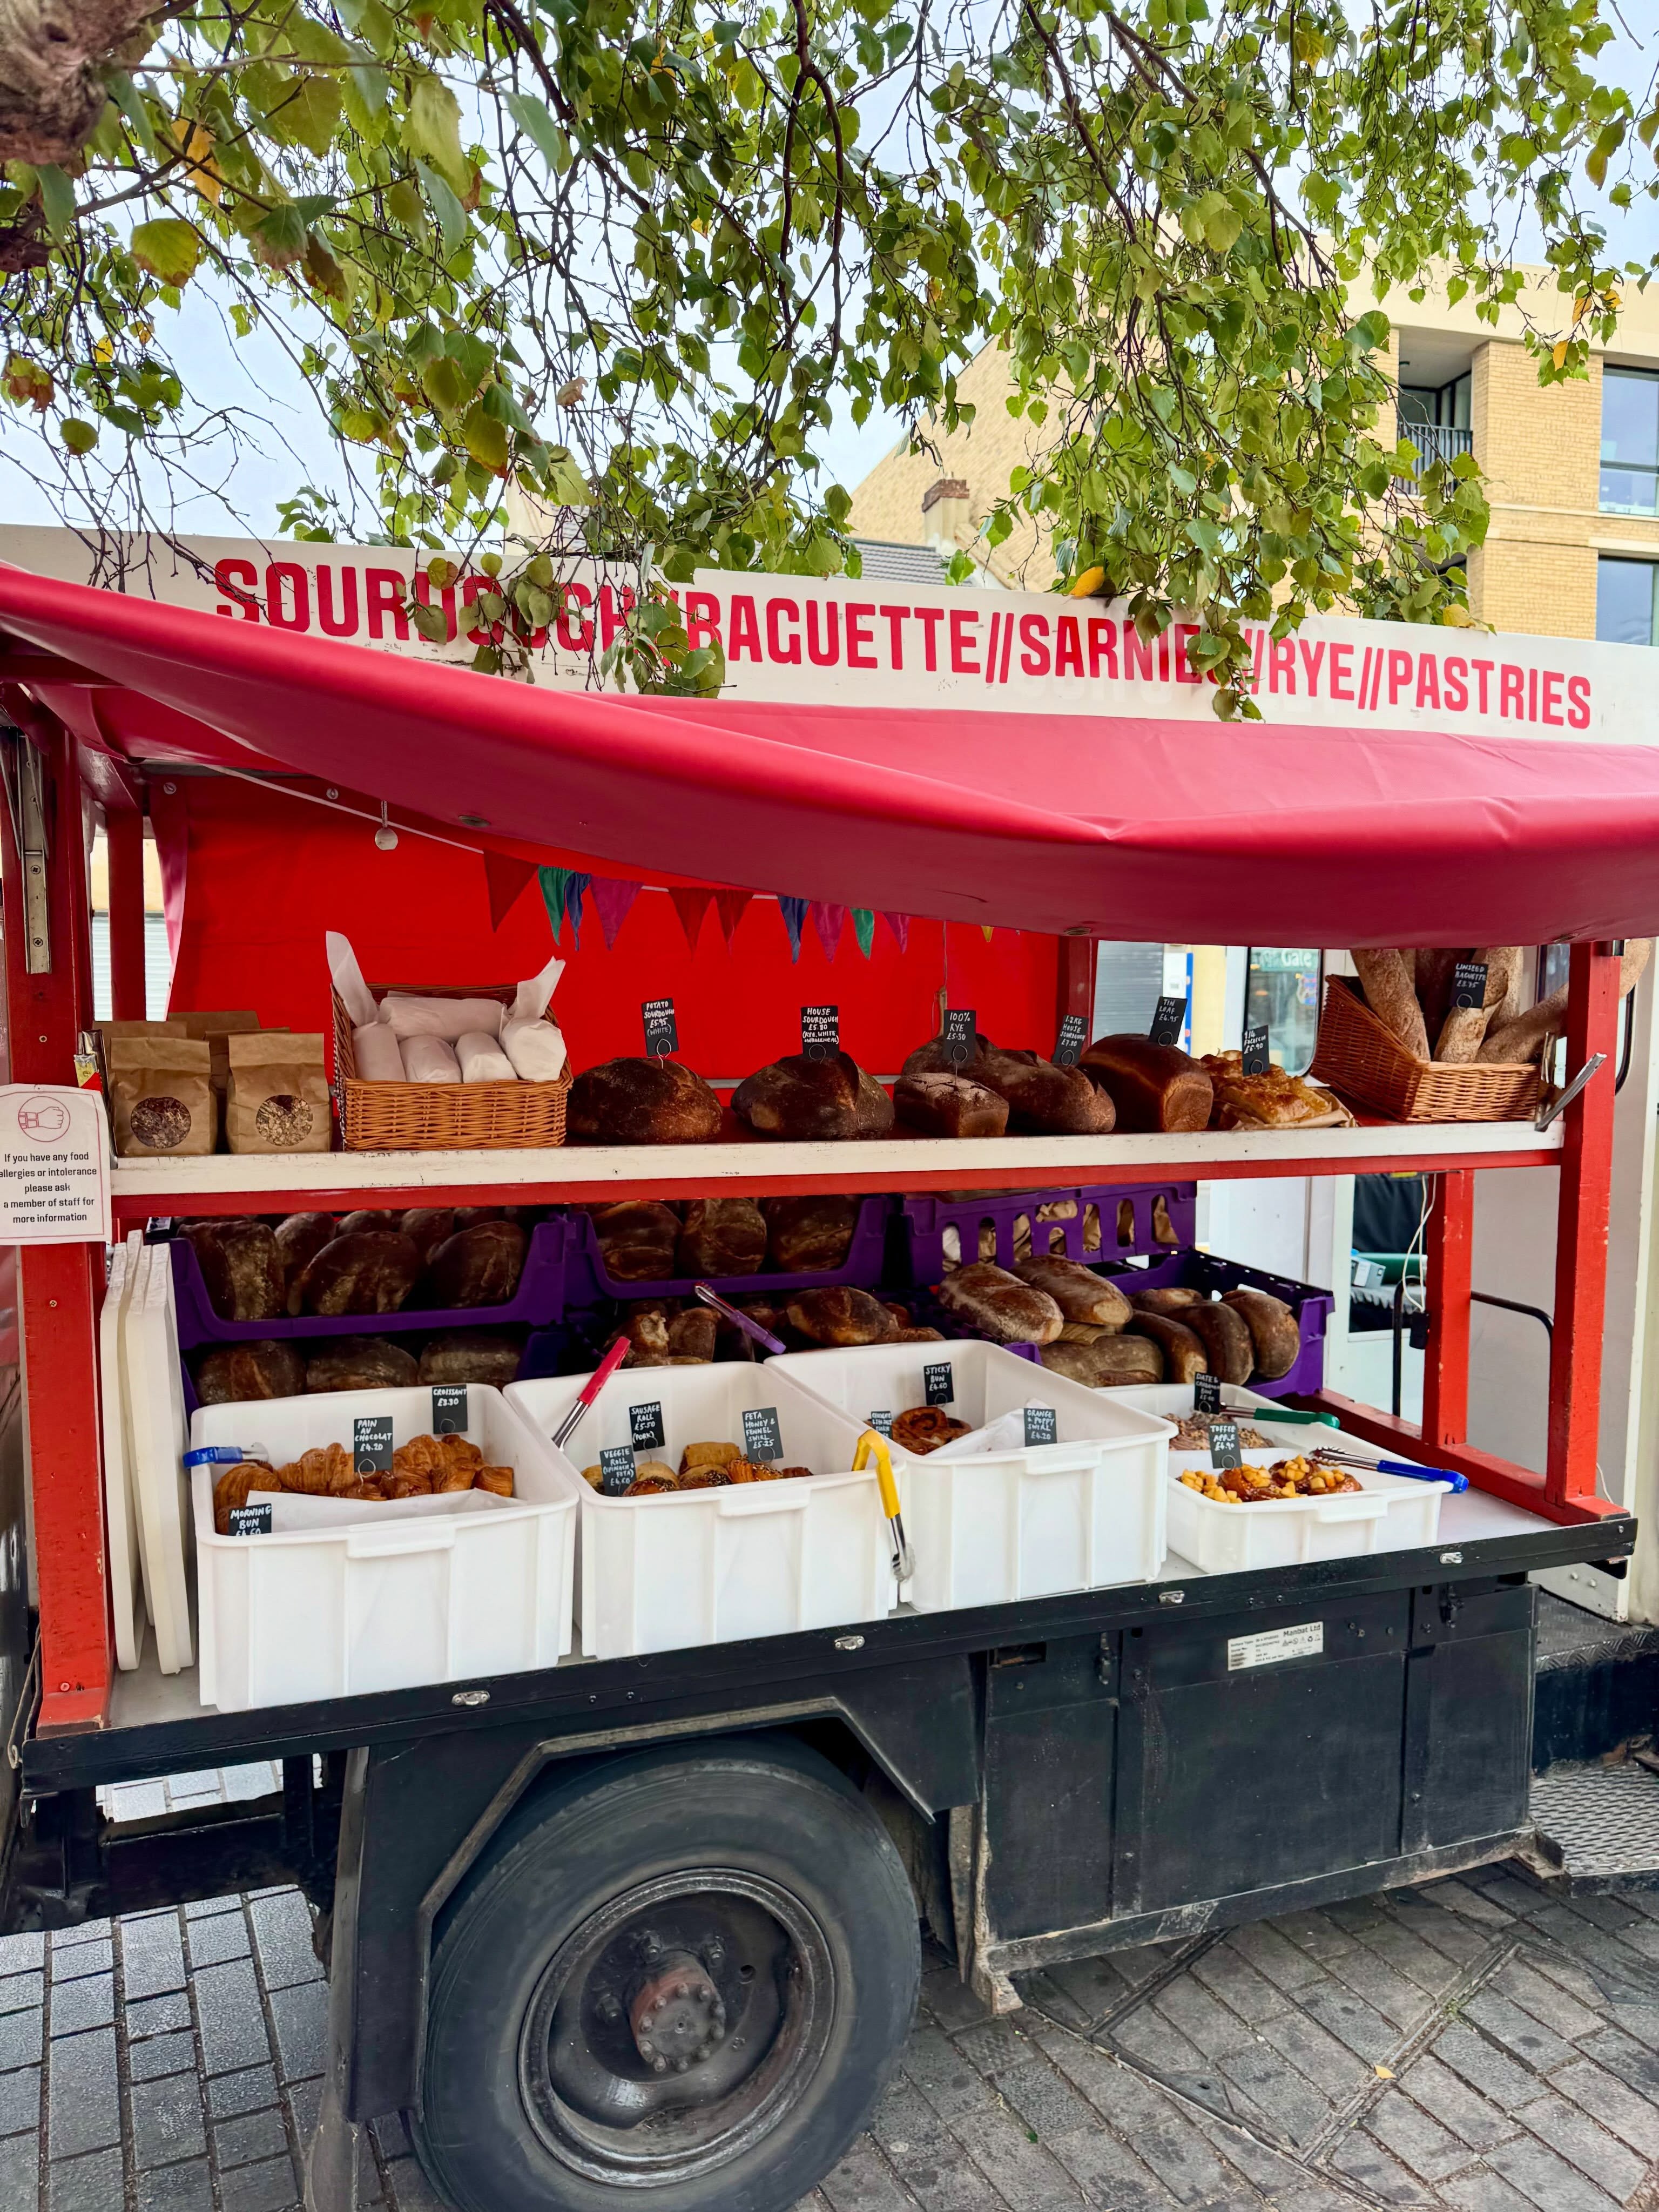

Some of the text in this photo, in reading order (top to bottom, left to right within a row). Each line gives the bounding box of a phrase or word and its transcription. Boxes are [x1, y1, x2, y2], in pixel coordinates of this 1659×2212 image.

[646, 1001, 669, 1010] POTATO
[1159, 1006, 1175, 1014] LOAF
[644, 1009, 675, 1019] SOURDOUGH
[950, 1012, 970, 1022] 100%
[802, 1016, 838, 1024] SOURDOUGH
[950, 1023, 964, 1031] RYE
[1063, 1023, 1081, 1033] HOUSE
[4, 1152, 89, 1164] If you have any food
[48, 1168, 97, 1176] intolerance
[24, 1183, 70, 1195] please ask
[11, 1199, 46, 1208] member
[48, 1198, 57, 1207] of
[59, 1197, 81, 1206] staff
[37, 1213, 87, 1223] information
[926, 1364, 950, 1375] STICKY
[631, 1405, 660, 1414] SAUSAGE
[1027, 1410, 1052, 1418] ORANGE
[637, 1413, 653, 1422] ROLL
[358, 1419, 377, 1429] PAIN
[635, 1421, 655, 1431] £5.50
[745, 1419, 768, 1428] HONEY
[746, 1427, 772, 1436] FENNEL
[355, 1433, 392, 1441] CHOCOLAT
[1213, 1434, 1235, 1442] APPLE
[360, 1443, 383, 1452] £4.20
[604, 1448, 630, 1459] VEGGIE
[610, 1458, 627, 1467] ROLL
[230, 1505, 271, 1519] MORNING
[239, 1518, 259, 1529] BUN
